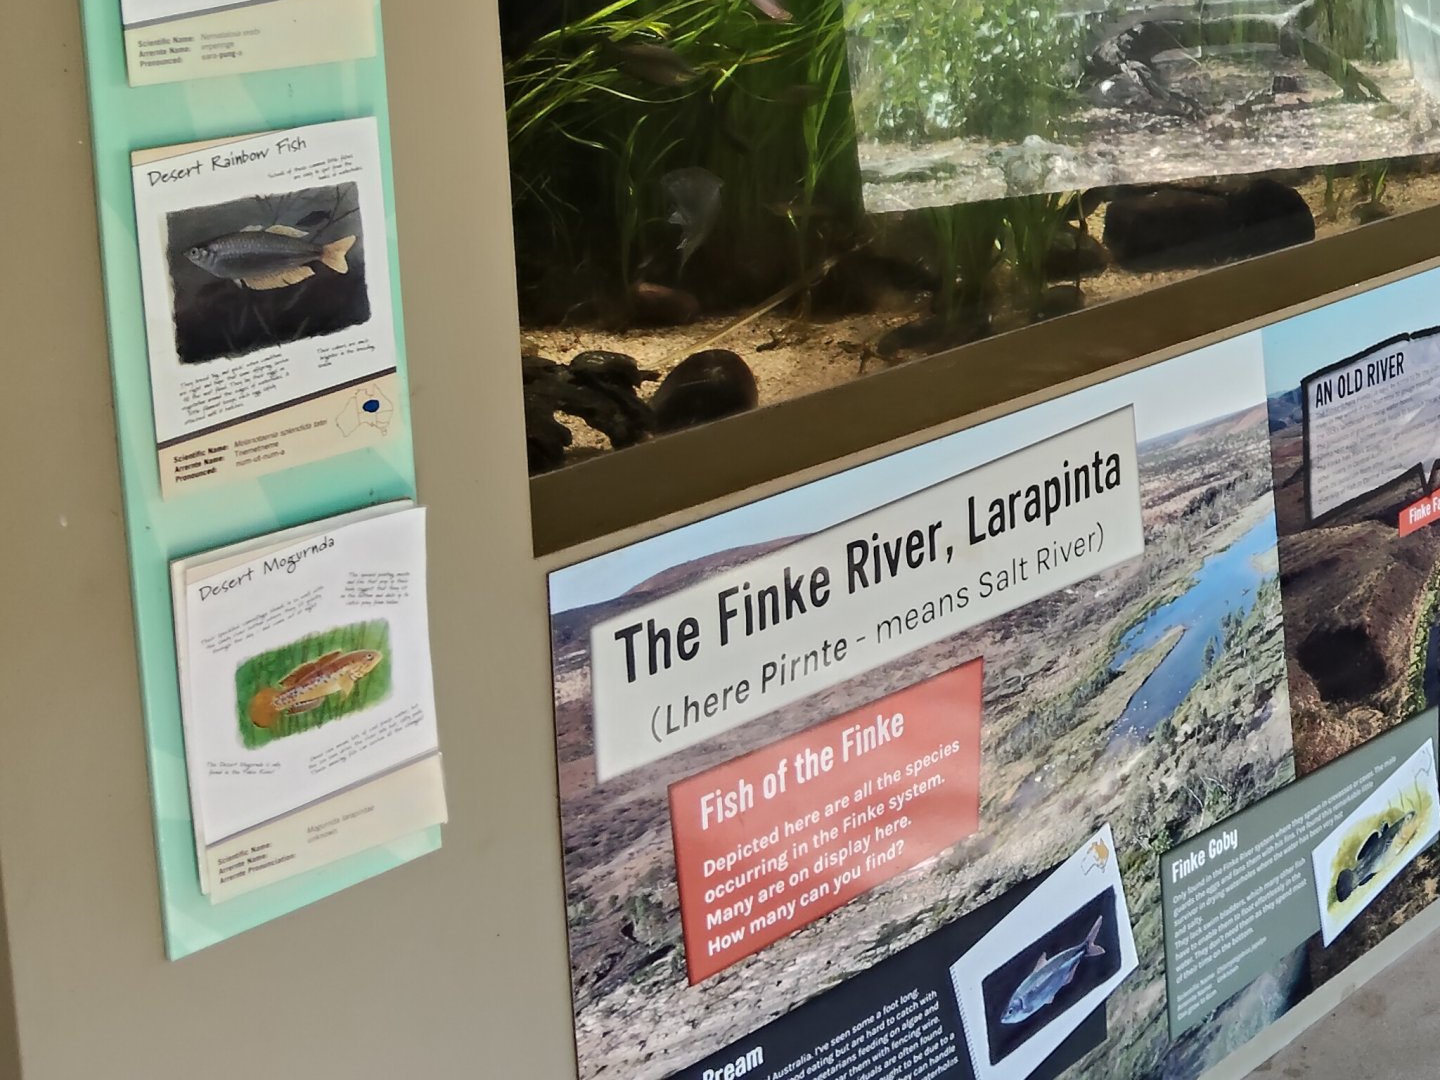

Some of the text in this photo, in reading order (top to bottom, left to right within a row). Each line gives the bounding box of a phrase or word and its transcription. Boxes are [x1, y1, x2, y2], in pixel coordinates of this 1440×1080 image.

[148, 160, 203, 187] Desert
[212, 147, 270, 170] Rainbow
[276, 137, 307, 154] Fish
[1315, 352, 1404, 409] AN OLD RIVER
[1409, 504, 1431, 524] Finke
[199, 536, 335, 601] Desert Mogurnda
[614, 450, 1121, 684] The Finke River, Larapinta
[651, 679, 751, 743] (Lhere
[761, 638, 847, 694] Pirnte
[877, 586, 970, 644] means
[978, 557, 1029, 598] Salt
[1036, 521, 1105, 574] River)
[700, 712, 904, 831] Fish of the Finke
[703, 740, 960, 878] Depicted here are all the species
[704, 776, 946, 904] occurring in the Finke system.
[1172, 829, 1238, 884] Finke Goby
[706, 815, 912, 930] Many are on display here.
[708, 839, 905, 957] How many can you find?
[772, 1053, 814, 1080] Australia.
[831, 1030, 850, 1046] seen
[852, 1015, 875, 1034] some
[876, 1011, 881, 1019] a
[883, 999, 899, 1015] foot
[806, 1053, 834, 1075] eating
[835, 1043, 850, 1057] but
[851, 1035, 865, 1048] are
[866, 1021, 885, 1038] hard
[886, 1016, 895, 1026] to
[896, 1001, 919, 1020] catch
[920, 990, 937, 1006] with
[849, 1058, 871, 1077] them
[872, 1046, 890, 1061] with
[891, 1027, 922, 1050] fencing
[858, 1032, 889, 1056] feeding
[890, 1027, 900, 1038] on
[901, 1012, 923, 1031] algae
[924, 1001, 939, 1016] and
[884, 1024, 943, 1069] are often found
[903, 1060, 912, 1069] to
[913, 1052, 923, 1064] be
[924, 1042, 939, 1056] due
[940, 1036, 948, 1046] to
[949, 1032, 955, 1040] a
[702, 1046, 764, 1080] Bream
[913, 1062, 928, 1076] can
[929, 1045, 955, 1066] handle
[921, 1056, 958, 1080] aterholes
